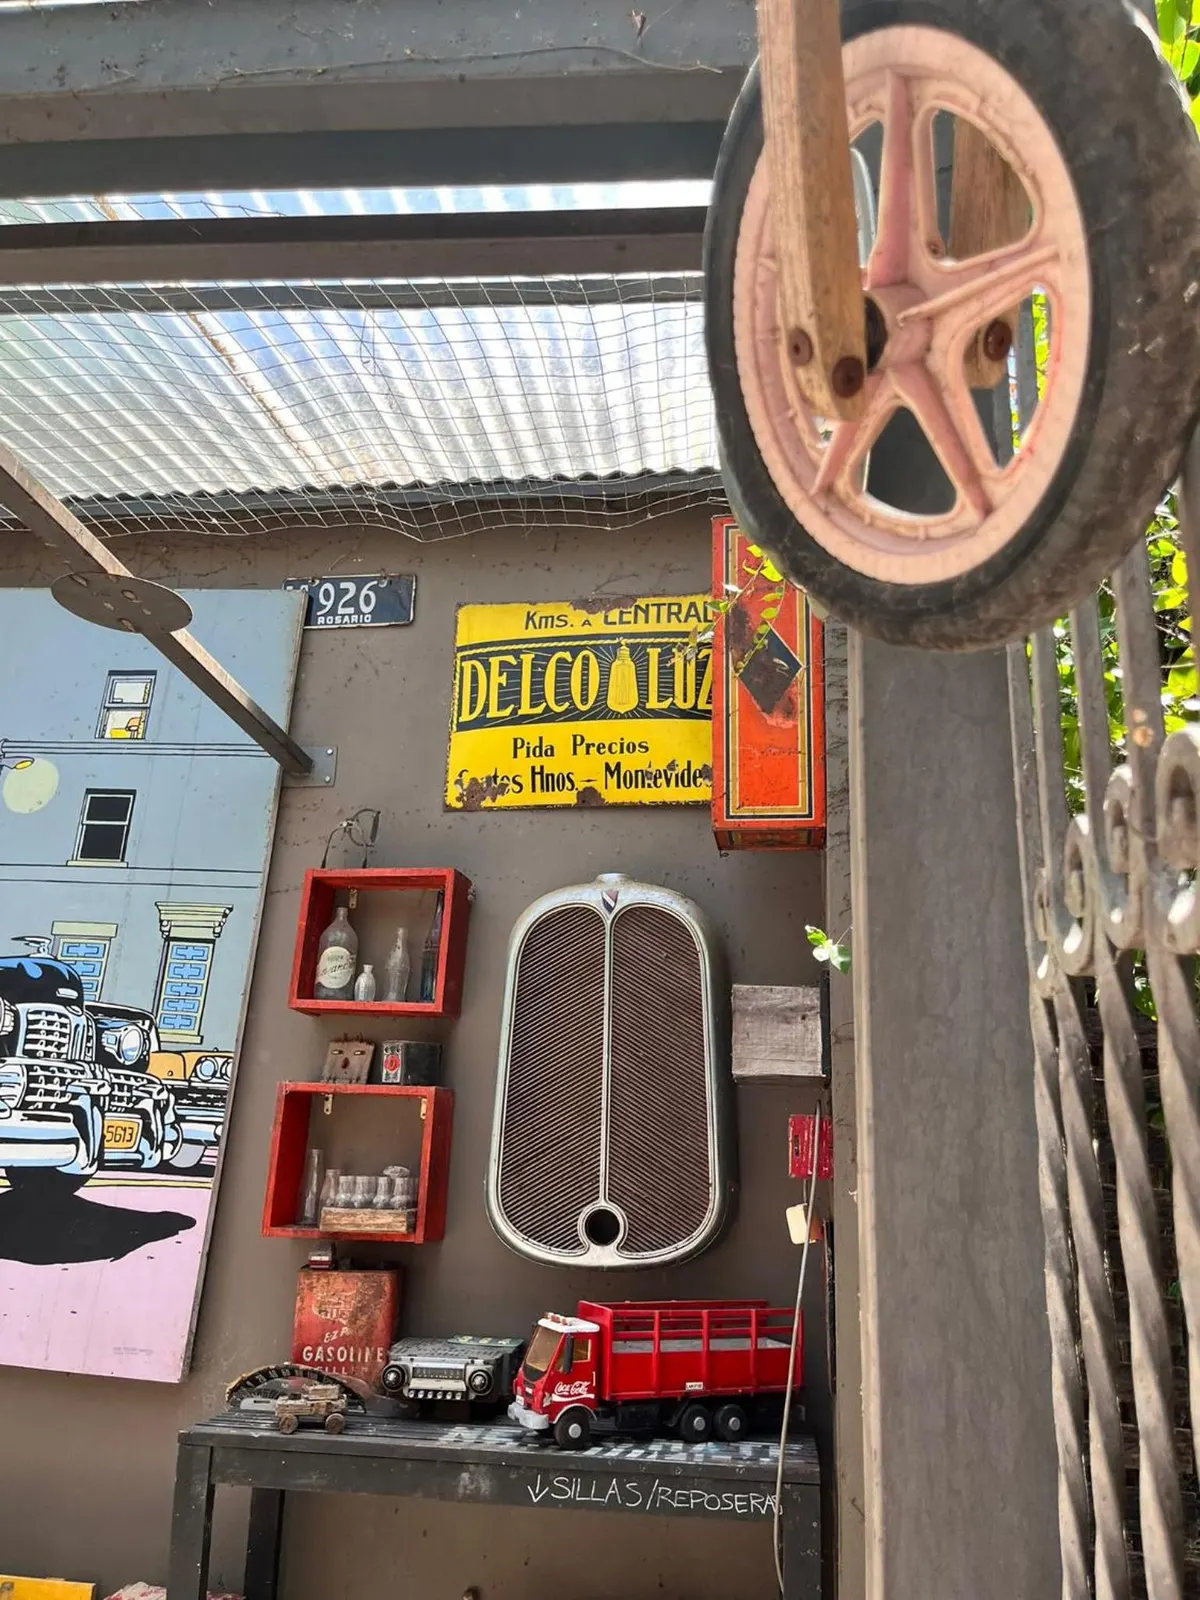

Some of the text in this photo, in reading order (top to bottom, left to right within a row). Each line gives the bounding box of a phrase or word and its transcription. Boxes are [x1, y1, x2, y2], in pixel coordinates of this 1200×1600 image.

[316, 581, 379, 616] 926
[317, 614, 372, 625] ROSARIO
[458, 647, 713, 723] DELCO LUZ
[511, 734, 650, 759] Pida Precios
[530, 764, 579, 793] Hnos.
[604, 759, 712, 791] Monevide
[105, 1124, 134, 1143] 5613
[302, 1345, 385, 1362] GASOLINE
